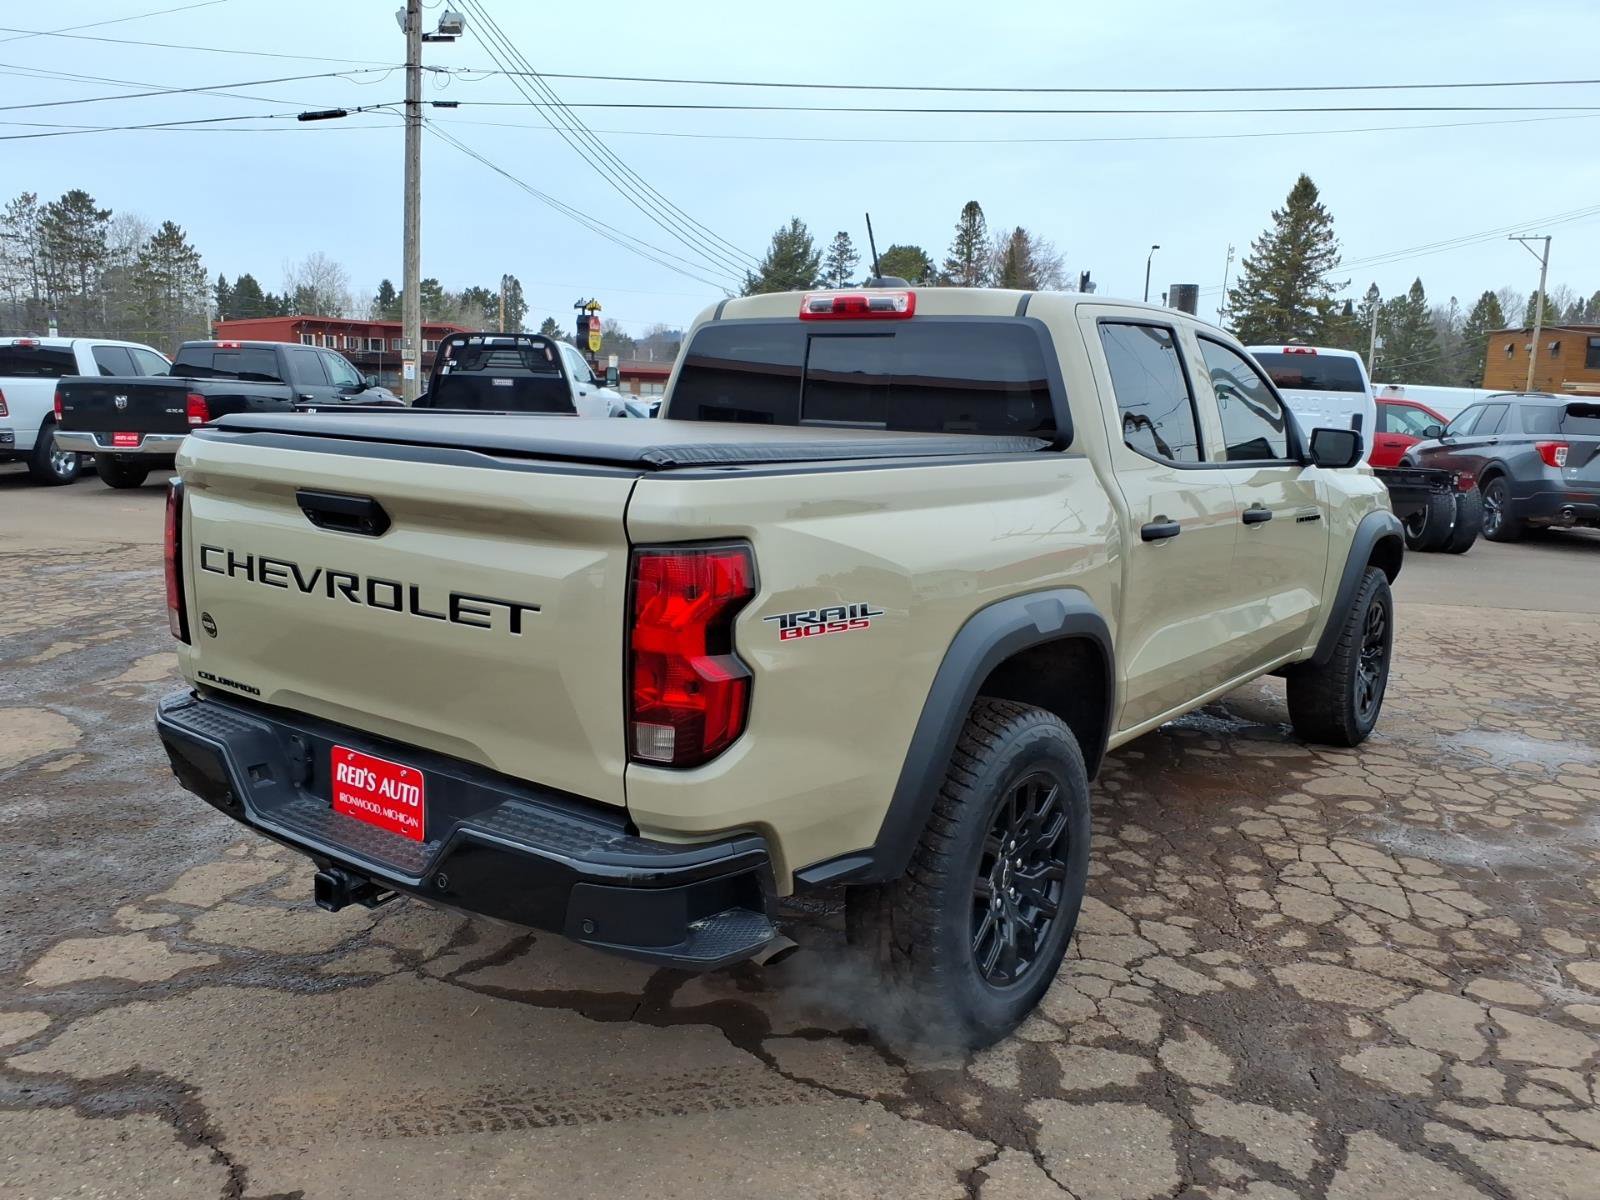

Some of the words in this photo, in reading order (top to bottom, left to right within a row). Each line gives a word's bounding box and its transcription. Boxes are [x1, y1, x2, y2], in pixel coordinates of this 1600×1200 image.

[201, 544, 541, 635] CHEVROLET
[763, 602, 884, 629] TRAIL
[780, 617, 871, 641] BOSS
[198, 670, 261, 697] COLORADO
[336, 762, 377, 792] RED'S
[378, 777, 420, 807] AUTO
[339, 791, 383, 817] IRONWOOD,
[382, 807, 419, 828] MICHIGAN
